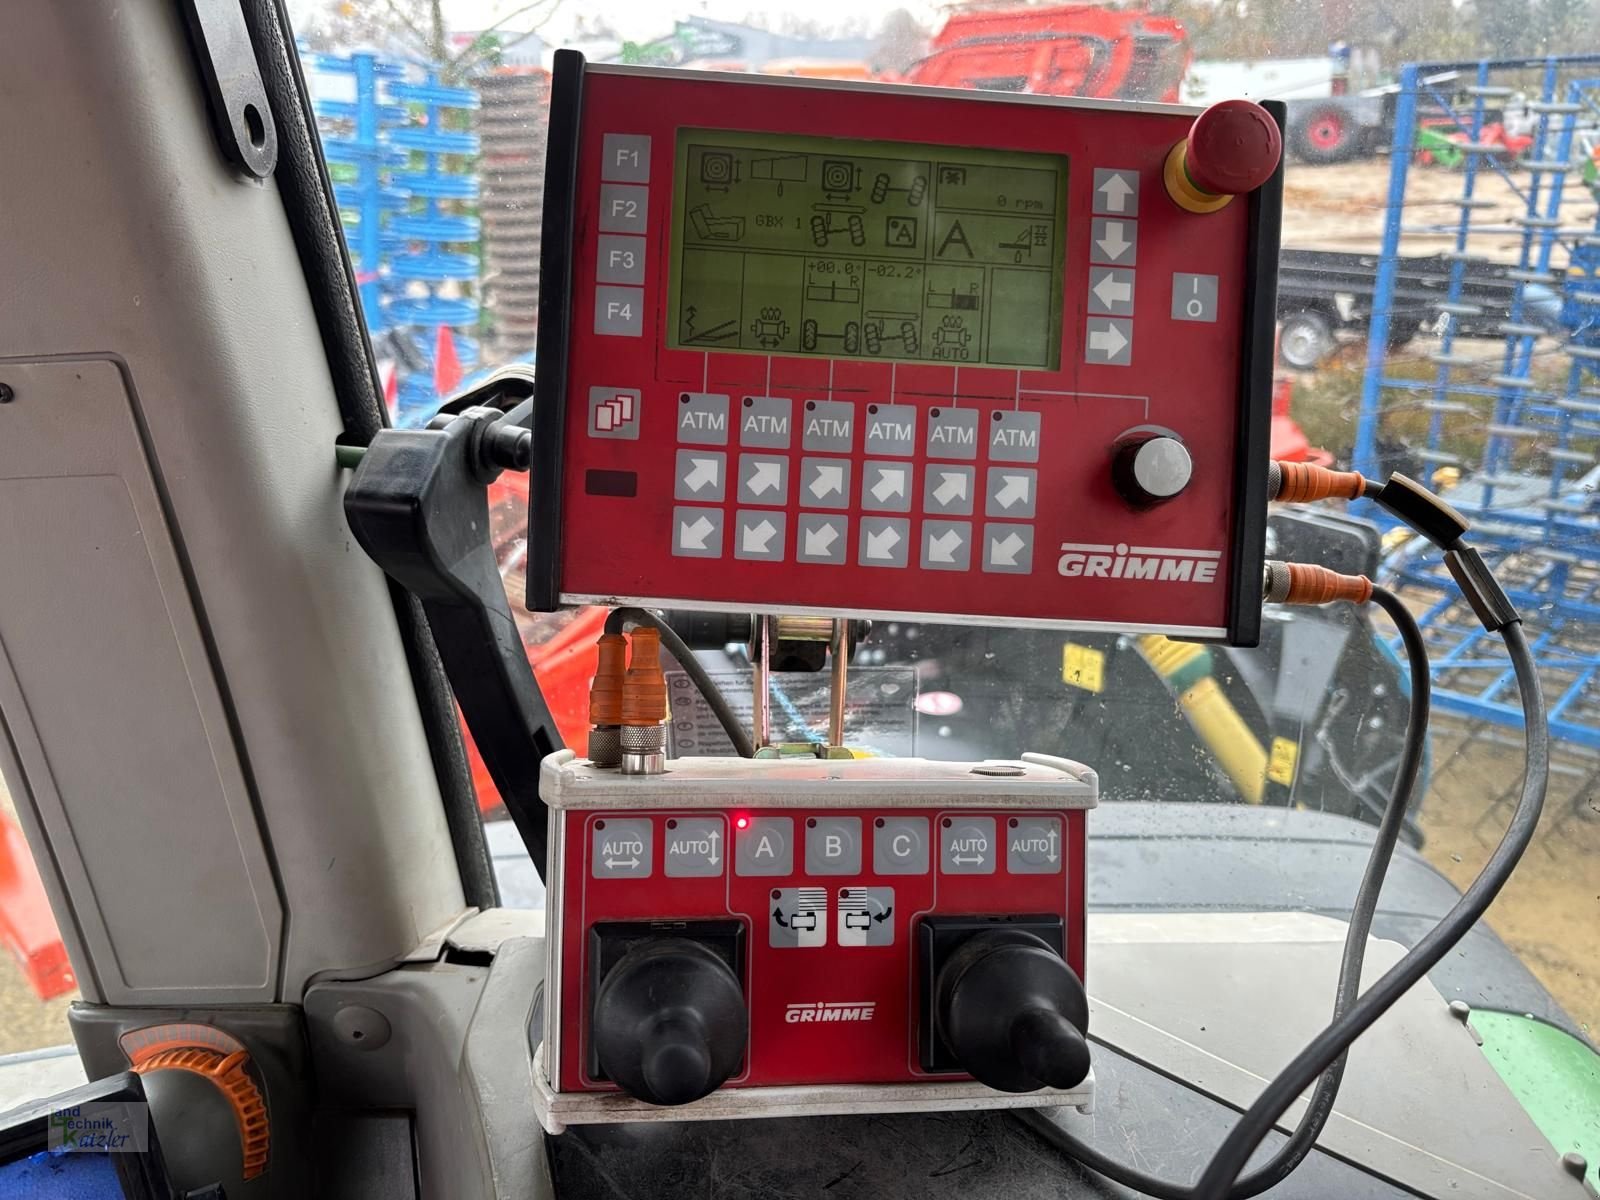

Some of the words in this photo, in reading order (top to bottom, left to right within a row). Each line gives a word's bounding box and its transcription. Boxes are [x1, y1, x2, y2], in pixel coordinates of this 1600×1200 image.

[616, 149, 639, 168] F1
[612, 200, 637, 218] F2
[1015, 198, 1044, 211] rpm
[936, 219, 975, 259] A
[609, 251, 634, 269] F3
[607, 302, 632, 320] F4
[932, 347, 970, 361] AUTO
[681, 411, 725, 431] ATM
[743, 415, 788, 435] ATM
[806, 418, 850, 438] ATM
[868, 421, 912, 442] ATM
[930, 425, 974, 445] ATM
[992, 428, 1036, 448] ATM
[602, 841, 643, 856] AUTO
[669, 840, 710, 855] AUTO
[755, 836, 775, 858] A
[825, 835, 842, 857] B
[892, 835, 911, 857] C
[950, 839, 988, 853] AUTO
[1011, 839, 1049, 853] AUTO
